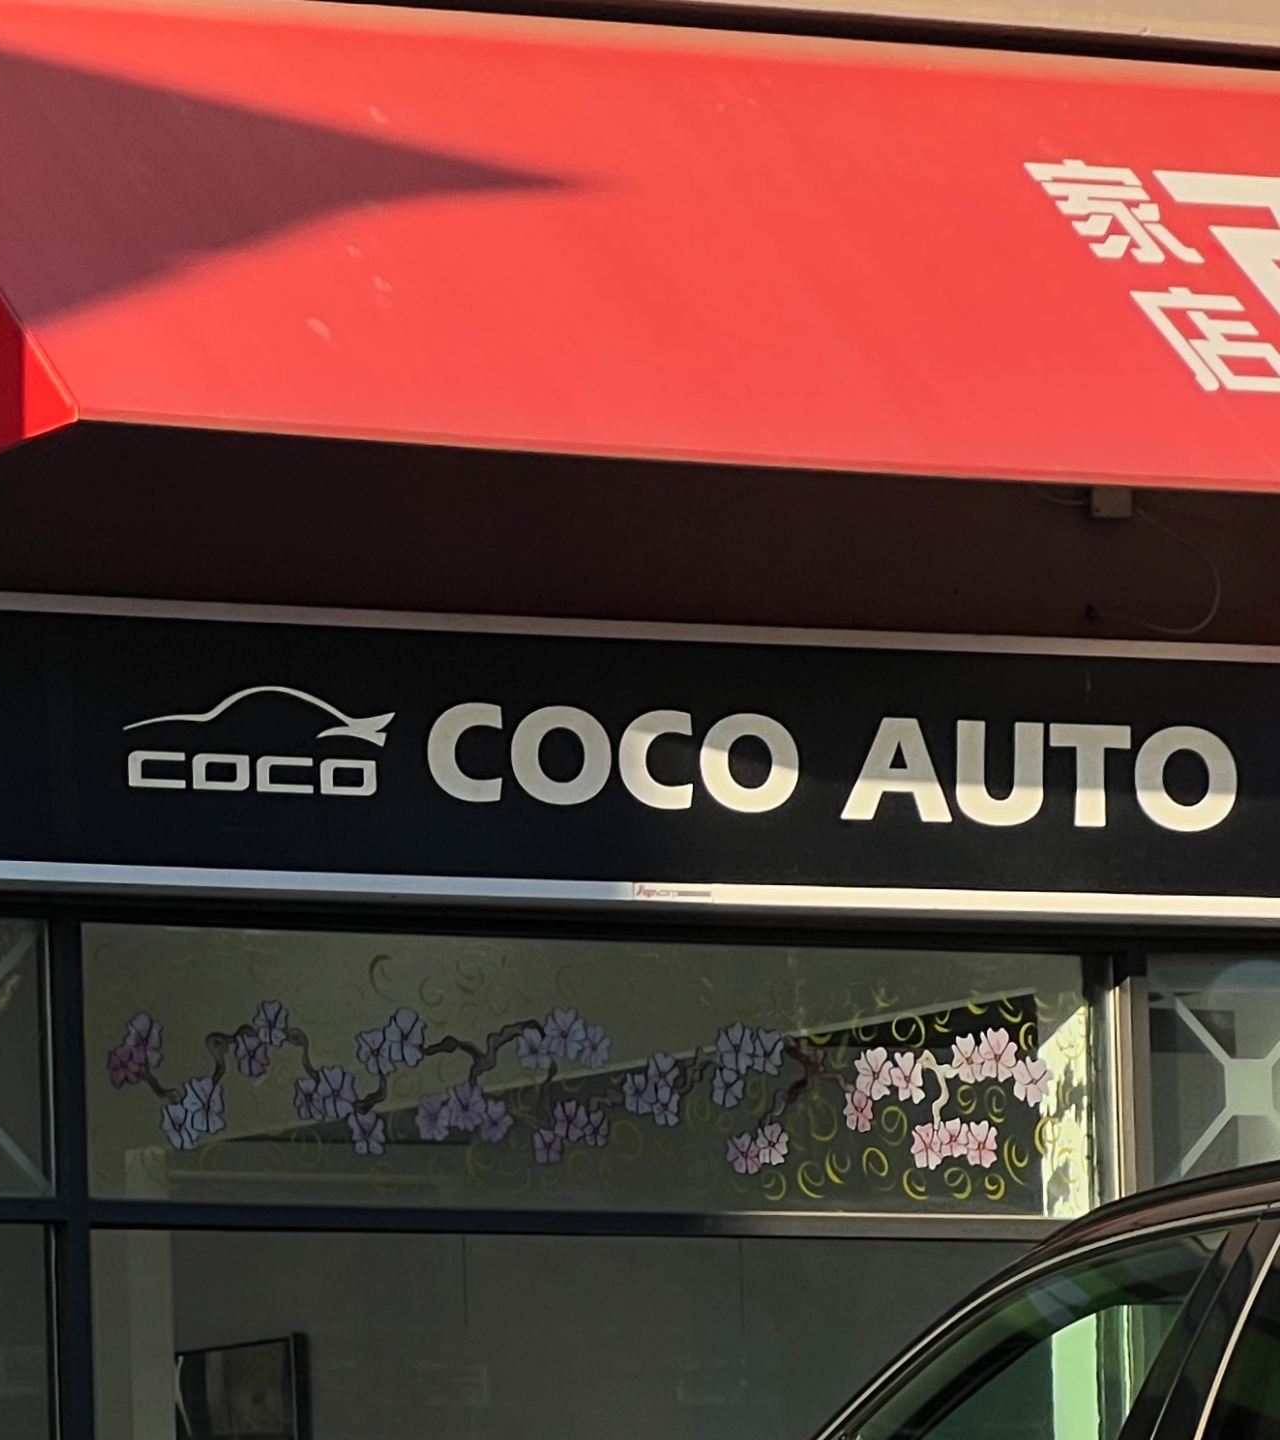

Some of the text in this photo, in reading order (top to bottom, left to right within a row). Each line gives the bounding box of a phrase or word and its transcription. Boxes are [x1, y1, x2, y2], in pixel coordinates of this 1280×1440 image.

[127, 750, 378, 797] COCO
[427, 702, 1238, 833] COCO AUTO
